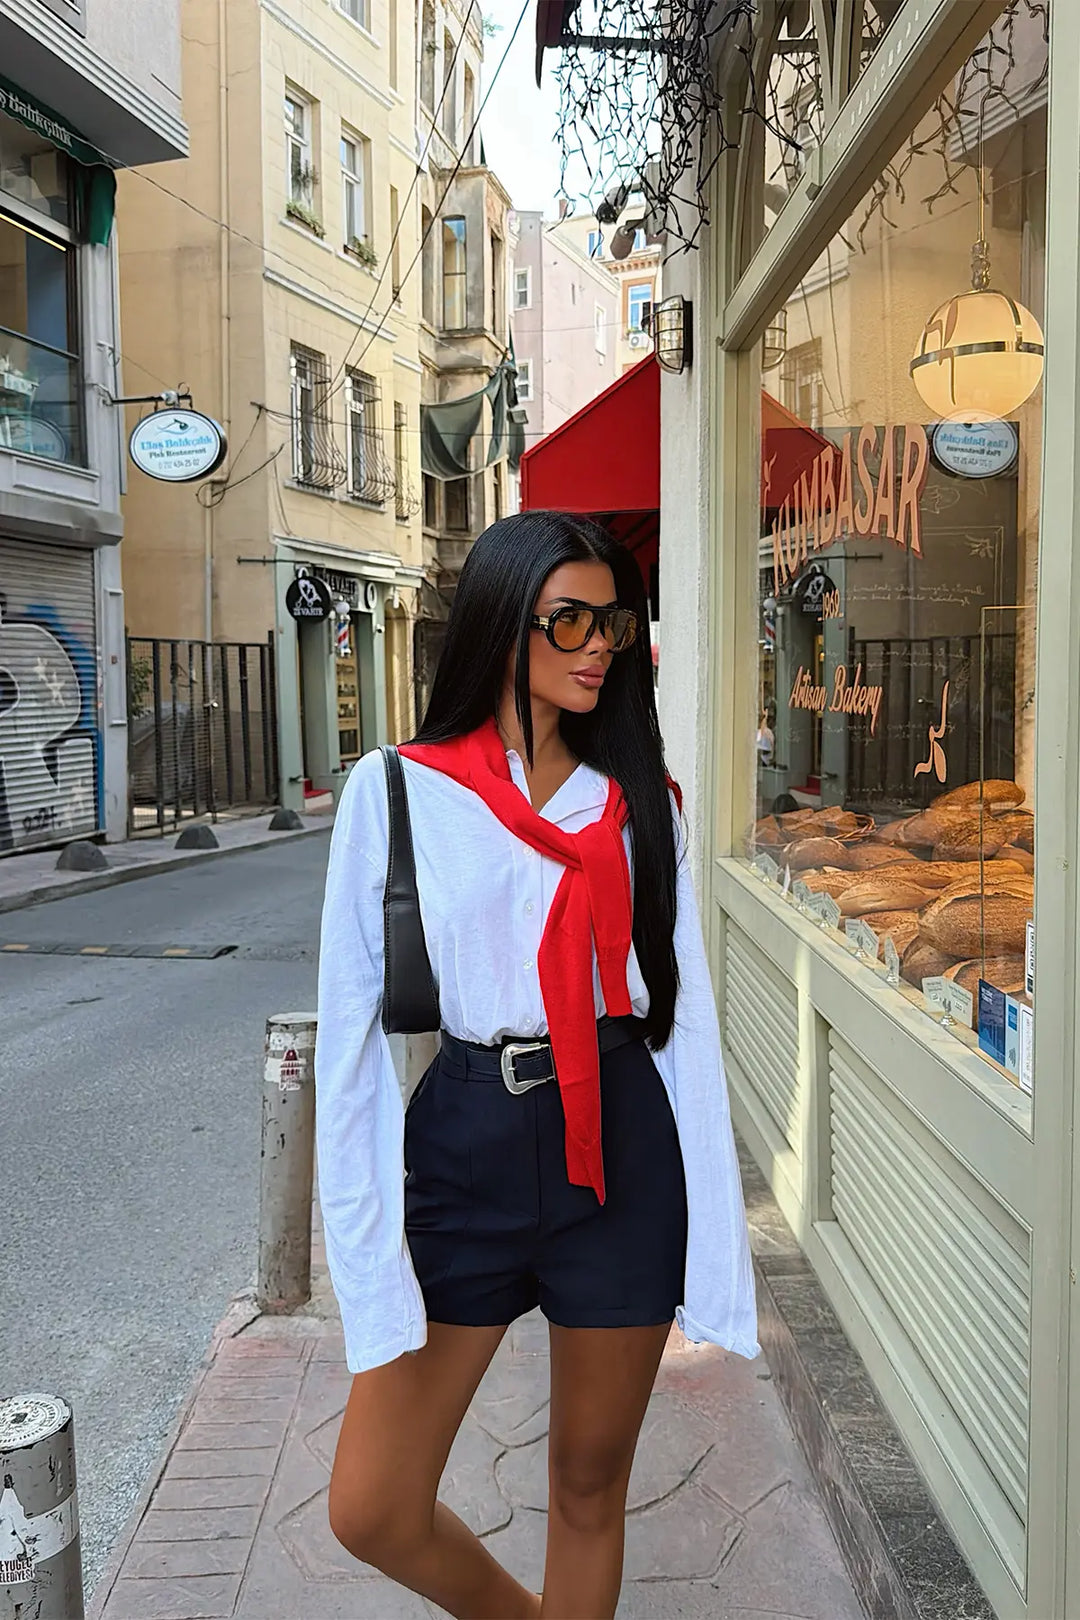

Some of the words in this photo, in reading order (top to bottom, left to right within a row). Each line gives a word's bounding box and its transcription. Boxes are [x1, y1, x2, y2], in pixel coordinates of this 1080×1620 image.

[772, 422, 929, 597] KUMBASAR
[788, 666, 827, 711] Artisan
[828, 662, 883, 736] Bakery
